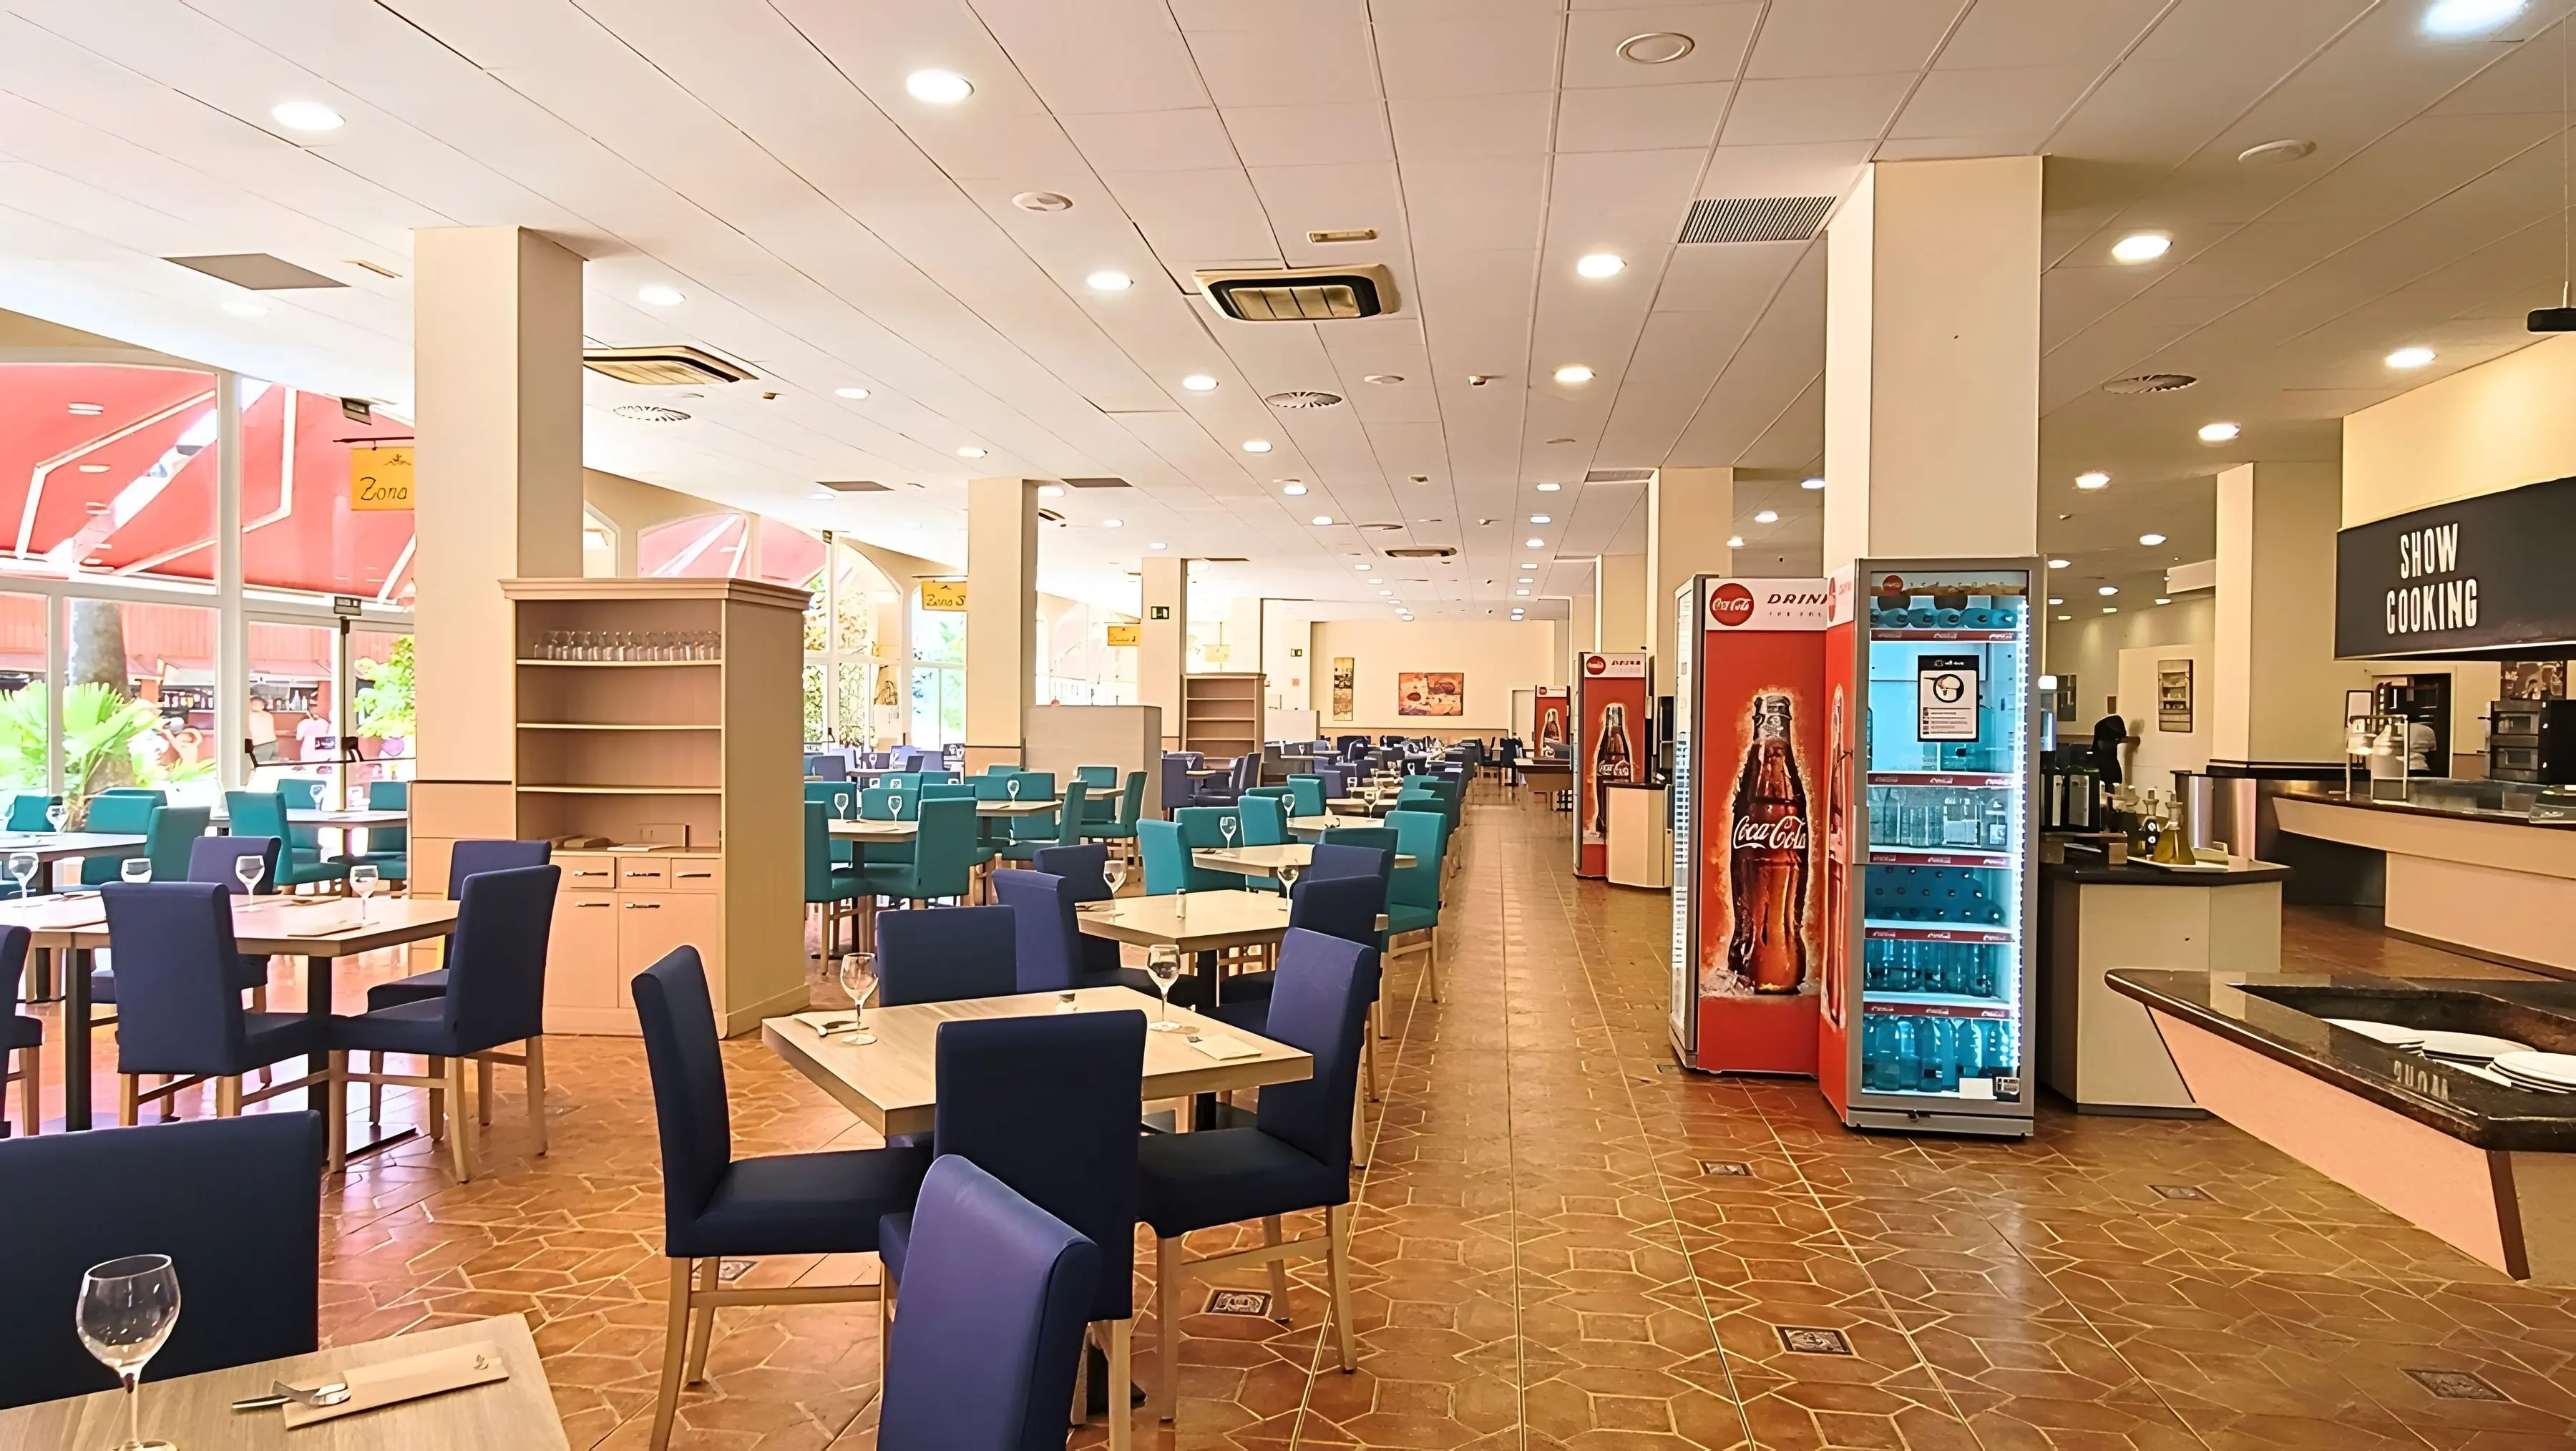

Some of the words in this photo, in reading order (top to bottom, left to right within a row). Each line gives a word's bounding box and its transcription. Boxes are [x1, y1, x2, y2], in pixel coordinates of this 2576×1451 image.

[360, 477, 407, 501] Zona
[2401, 523, 2458, 579] SHOW
[2386, 579, 2477, 635] COOKING
[1733, 815, 1806, 849] Coca-Cola
